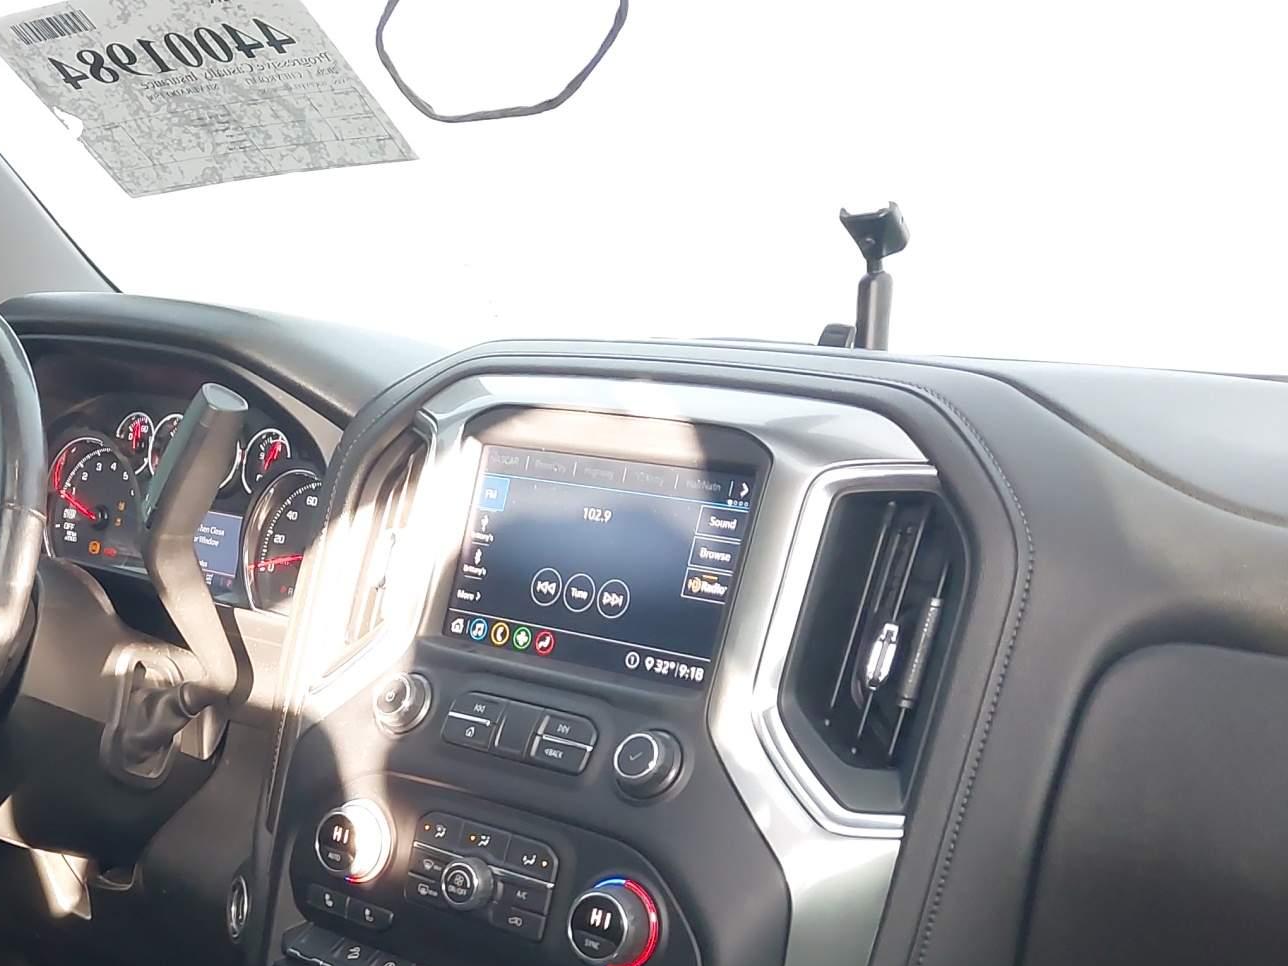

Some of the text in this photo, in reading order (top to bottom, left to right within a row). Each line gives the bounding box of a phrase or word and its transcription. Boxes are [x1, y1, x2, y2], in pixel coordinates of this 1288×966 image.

[96, 462, 102, 471] 3
[111, 462, 117, 471] 4
[82, 472, 88, 480] 2
[123, 472, 128, 480] 5
[306, 496, 318, 506] 60
[286, 510, 298, 520] 40
[583, 507, 612, 523] 102.9
[709, 516, 737, 530] Sound
[274, 534, 285, 544] 20
[699, 547, 731, 562] Browse
[457, 589, 475, 601] More
[570, 587, 588, 600] Tune
[679, 663, 704, 682] 9:18
[333, 825, 350, 843] HI
[516, 889, 529, 900] A/C
[590, 907, 612, 930] HI
